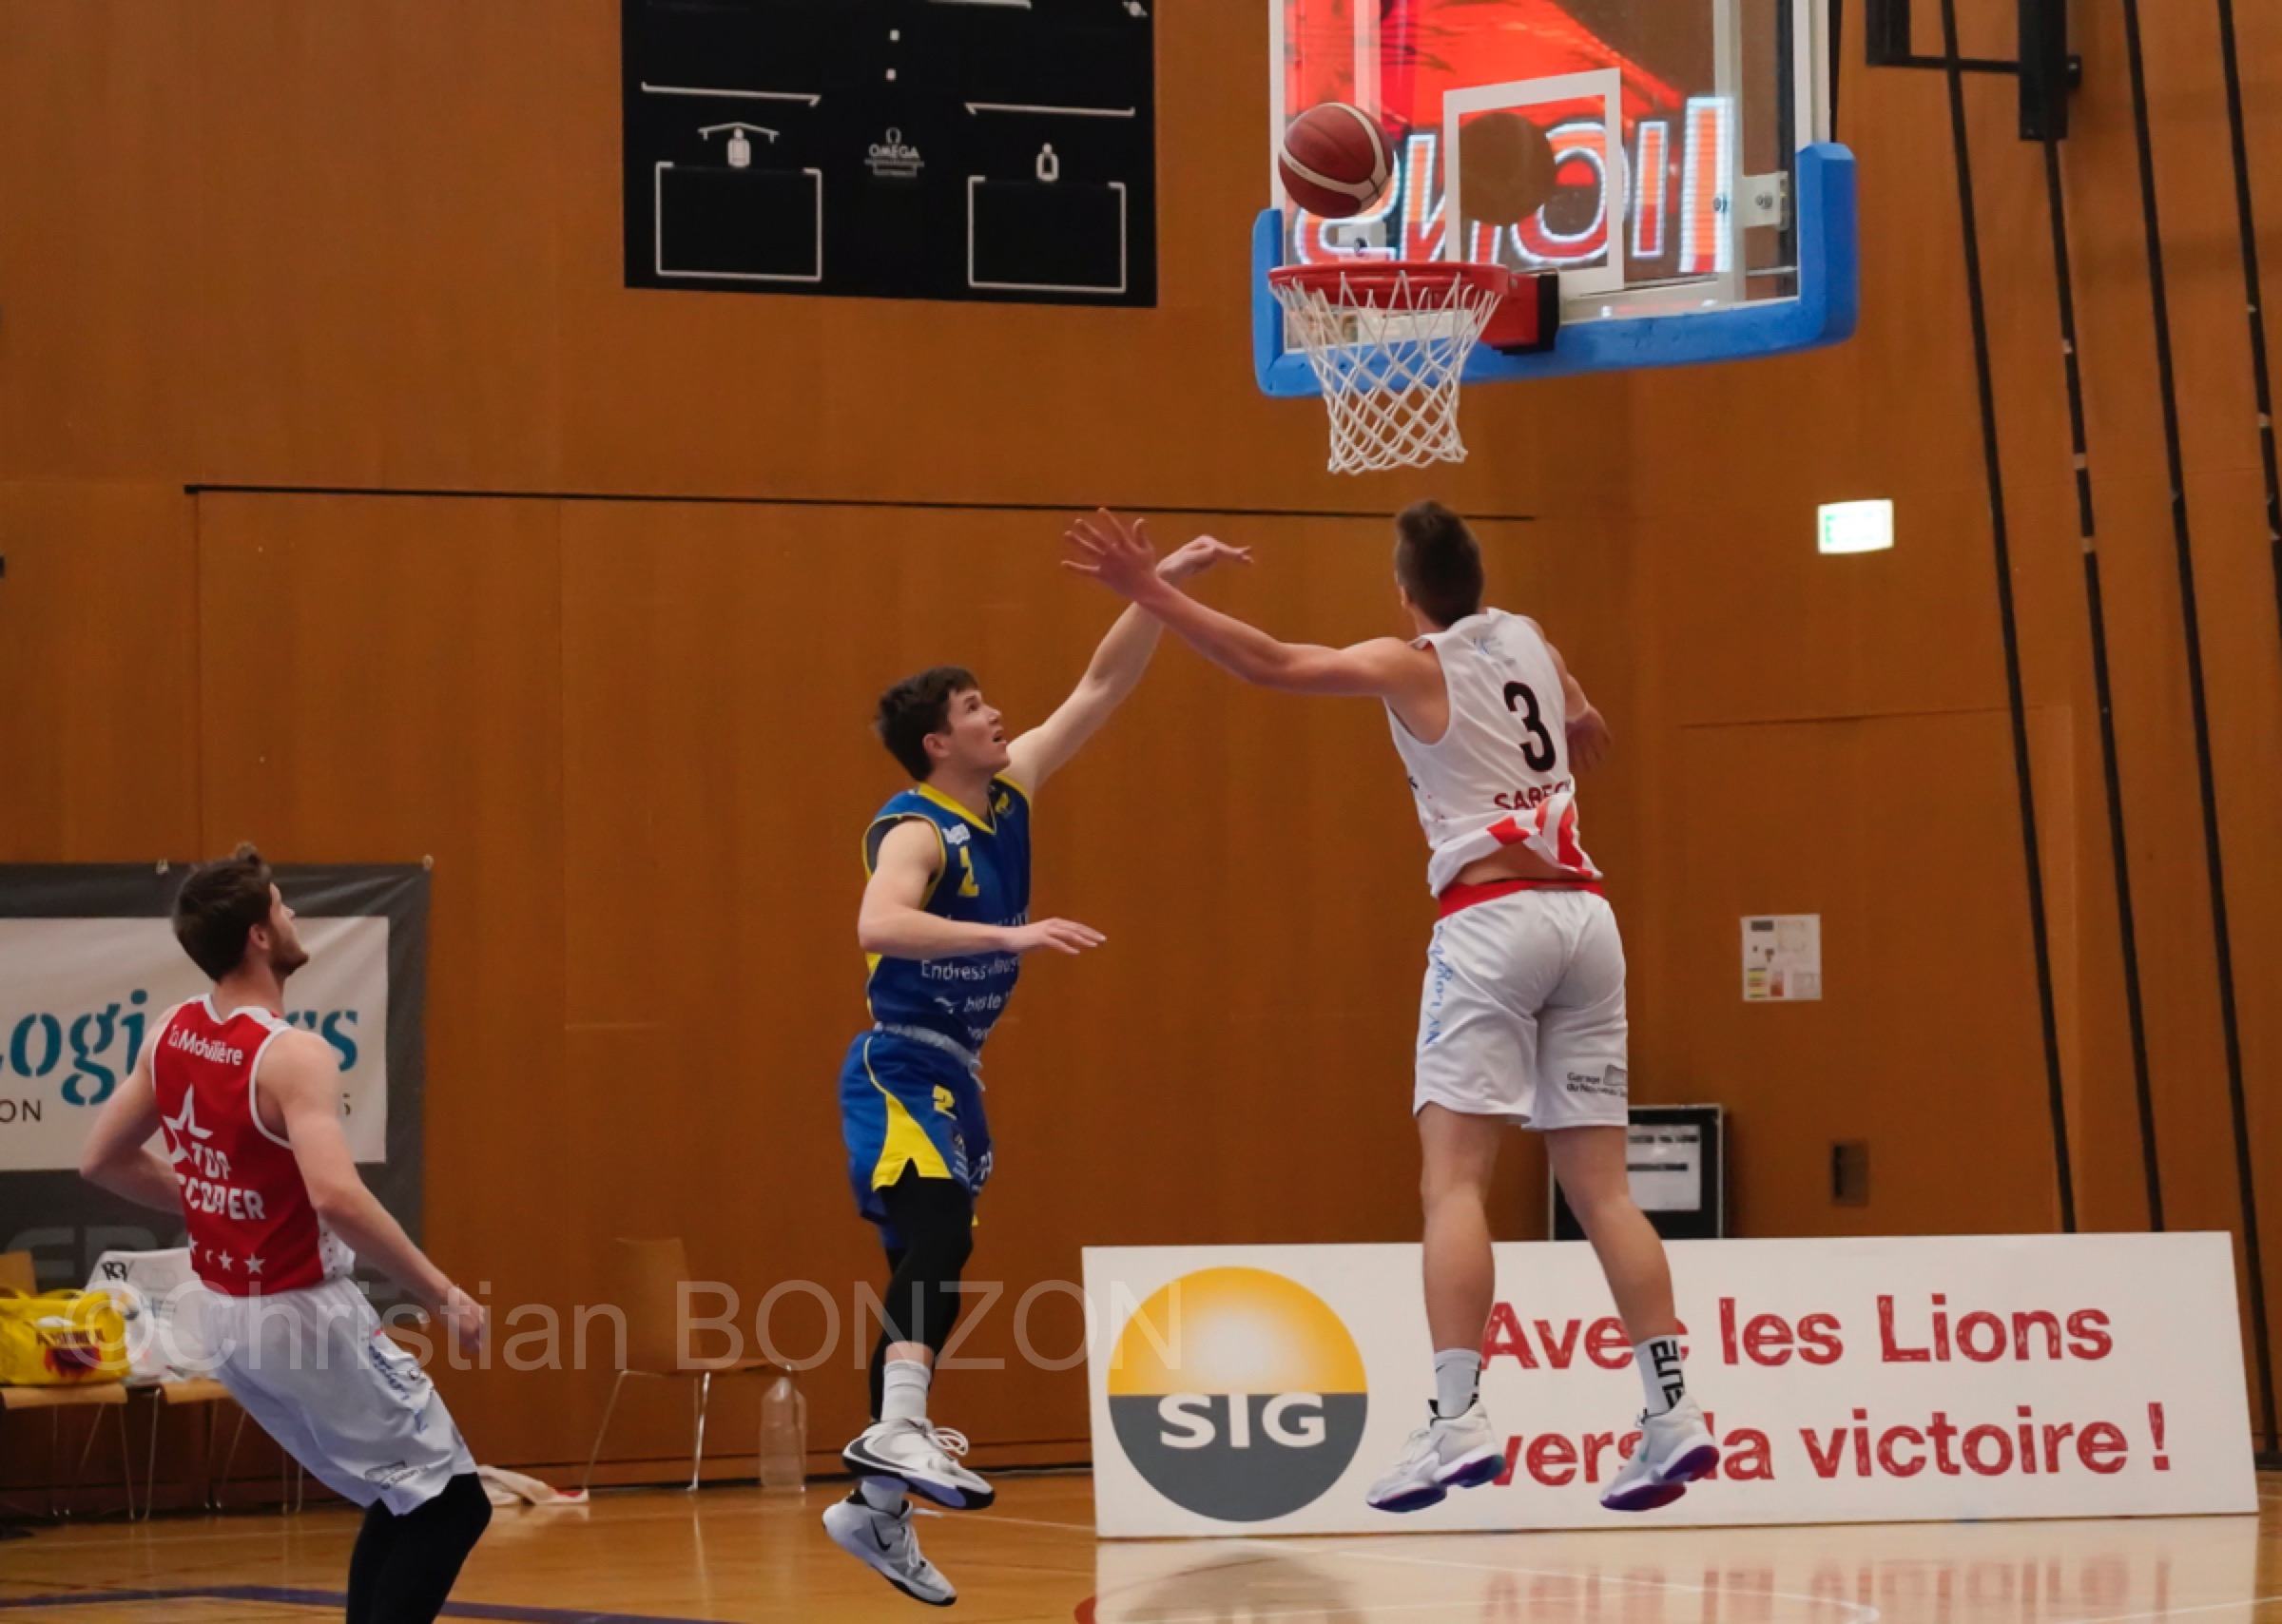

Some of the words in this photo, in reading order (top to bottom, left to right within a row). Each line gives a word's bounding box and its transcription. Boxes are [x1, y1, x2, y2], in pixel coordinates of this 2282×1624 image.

[868, 144, 919, 160] OMEGA
[1503, 681, 1556, 772] 3
[932, 1084, 957, 1121] 2
[176, 1172, 266, 1221] CORER
[1718, 1297, 1844, 1366] les
[1876, 1292, 2113, 1363] Lions
[1158, 1392, 1325, 1449] SIG
[1799, 1404, 2130, 1479] victoire
